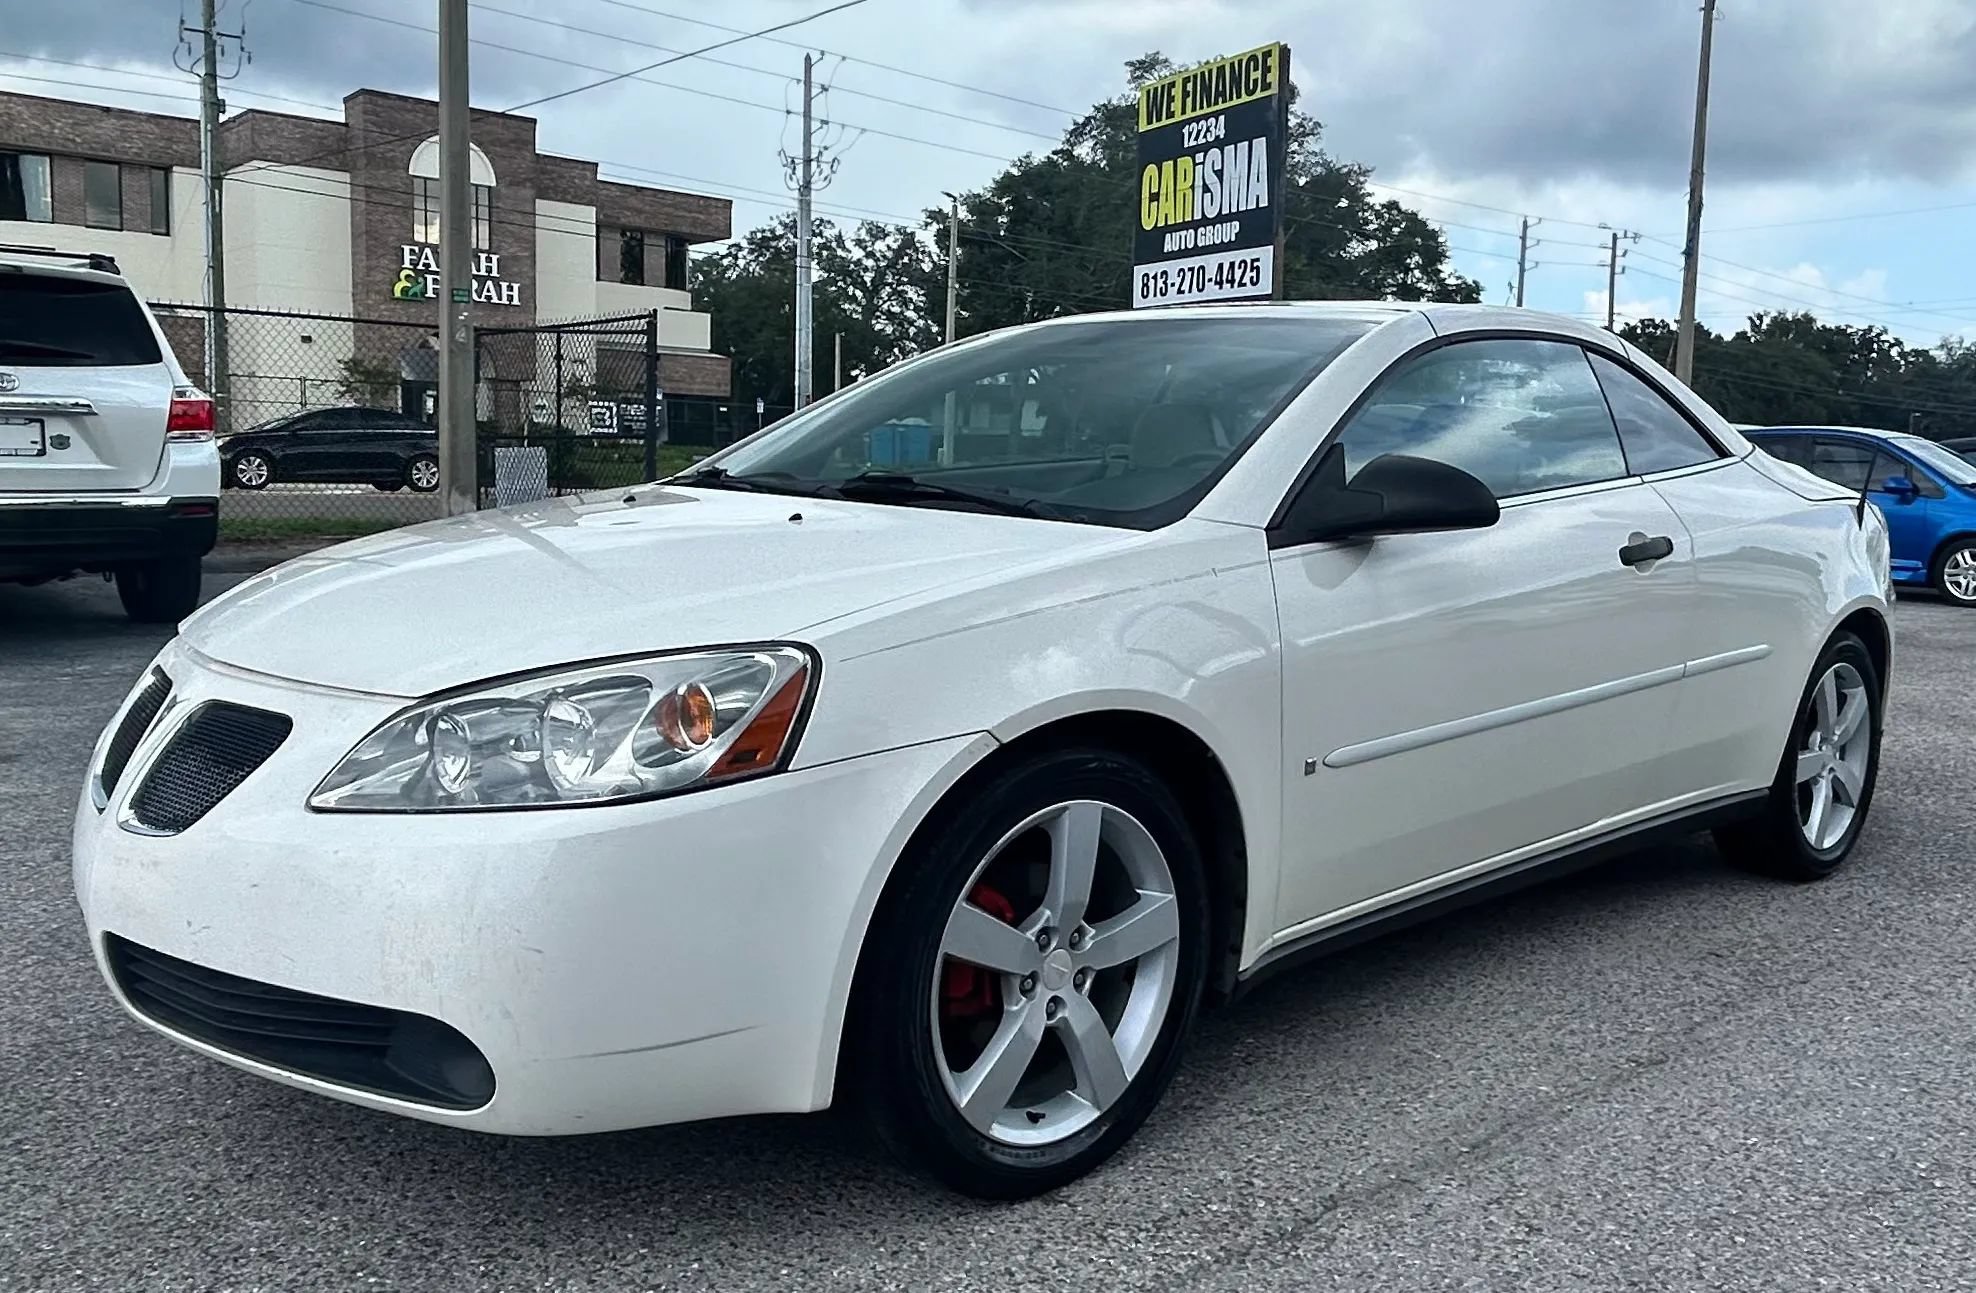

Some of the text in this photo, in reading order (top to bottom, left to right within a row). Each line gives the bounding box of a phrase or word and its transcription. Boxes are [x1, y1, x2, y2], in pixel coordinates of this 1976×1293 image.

[1146, 49, 1273, 126] WE FINANCE
[1182, 115, 1226, 148] 12234
[1163, 221, 1240, 253] AUTO GROUP
[401, 244, 500, 277] FAH
[424, 273, 520, 306] FRAH
[1140, 257, 1261, 299] 813-270-4425
